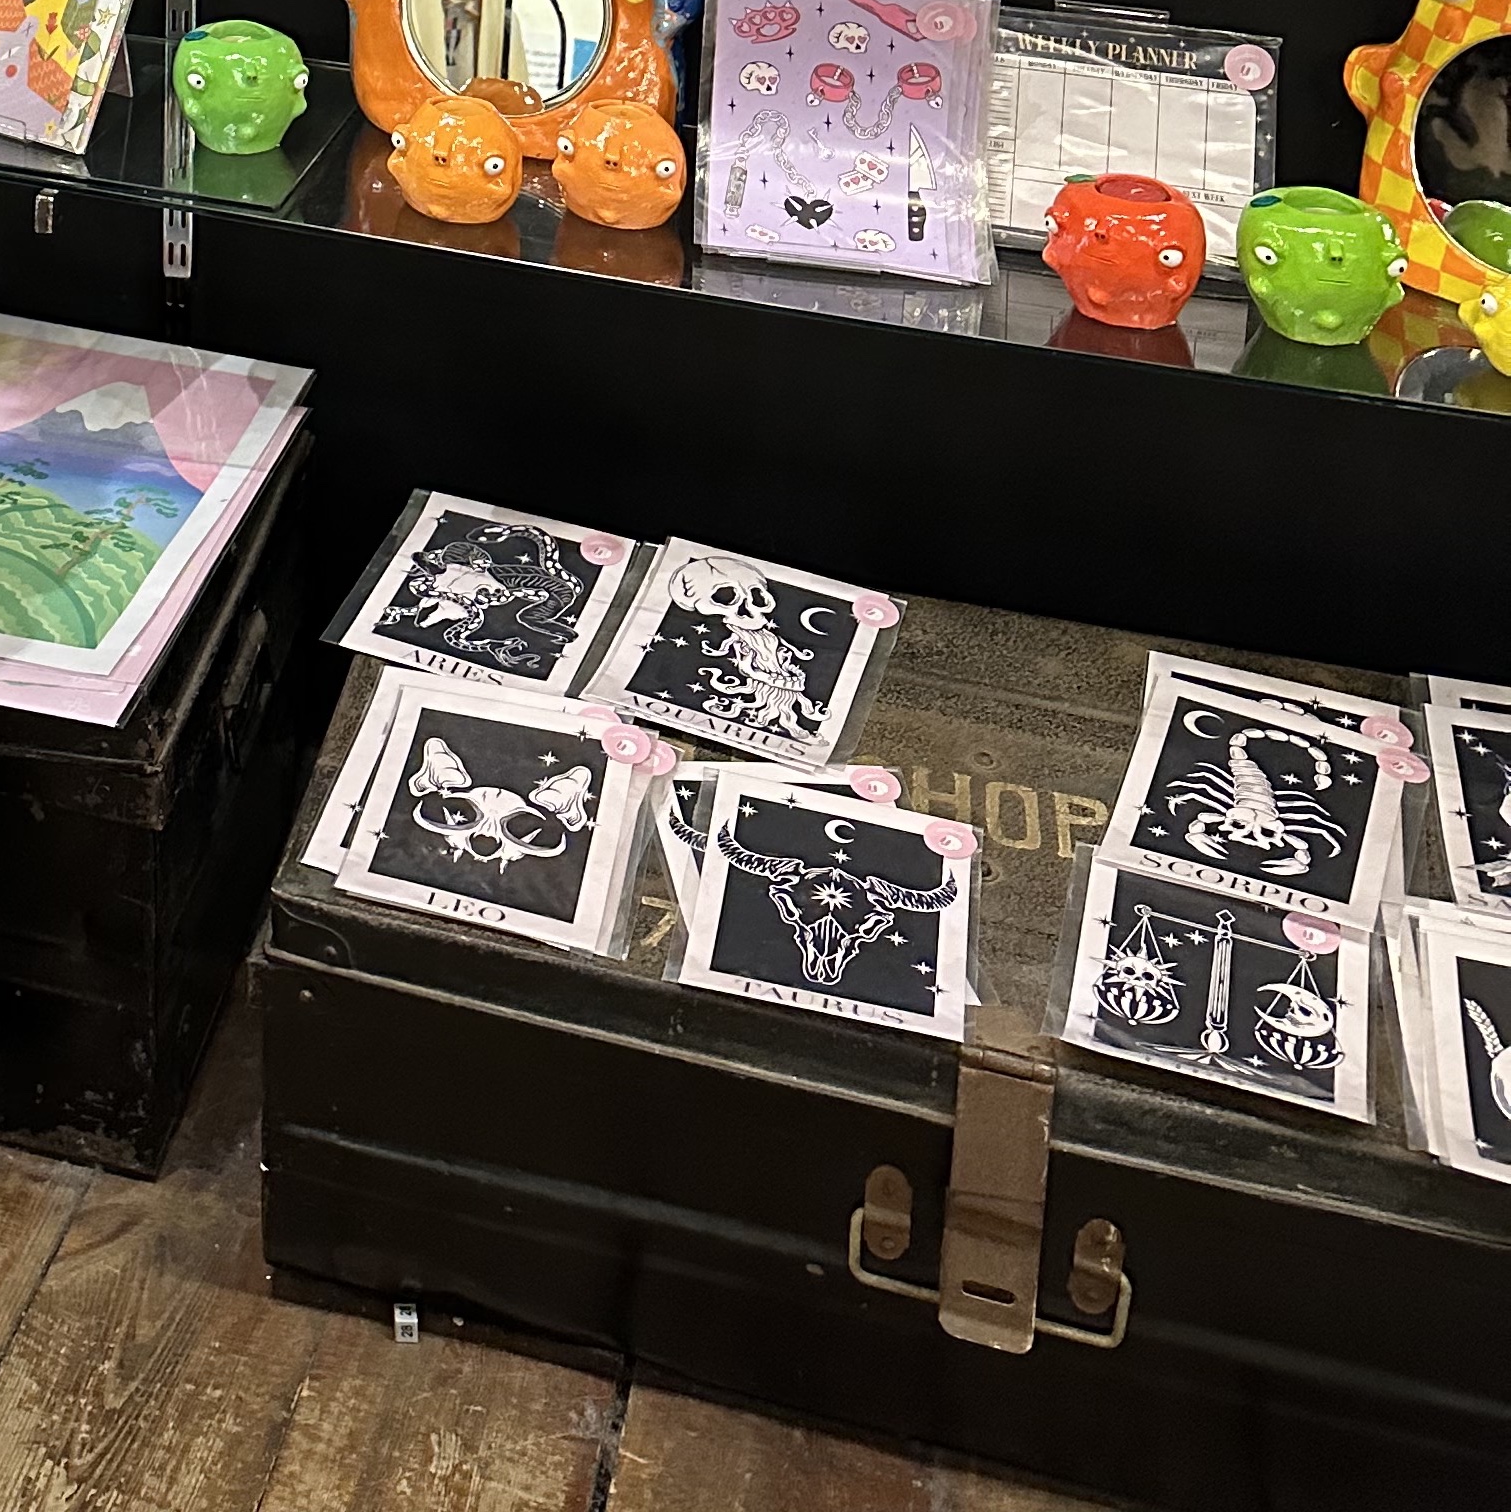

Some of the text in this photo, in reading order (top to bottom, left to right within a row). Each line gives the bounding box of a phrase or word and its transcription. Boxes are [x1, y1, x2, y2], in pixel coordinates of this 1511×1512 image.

[1017, 33, 1197, 70] WEEKLY PLANNER
[1204, 193, 1226, 203] WEEK
[400, 649, 505, 686] ARIES
[624, 695, 807, 757] AQUARIUS
[907, 766, 1110, 859] HOP
[1138, 853, 1331, 915] SCORPIO
[1468, 893, 1511, 909] SA
[425, 891, 506, 924] LEO
[735, 979, 904, 1024] TAURUS
[401, 1325, 413, 1338] 28
